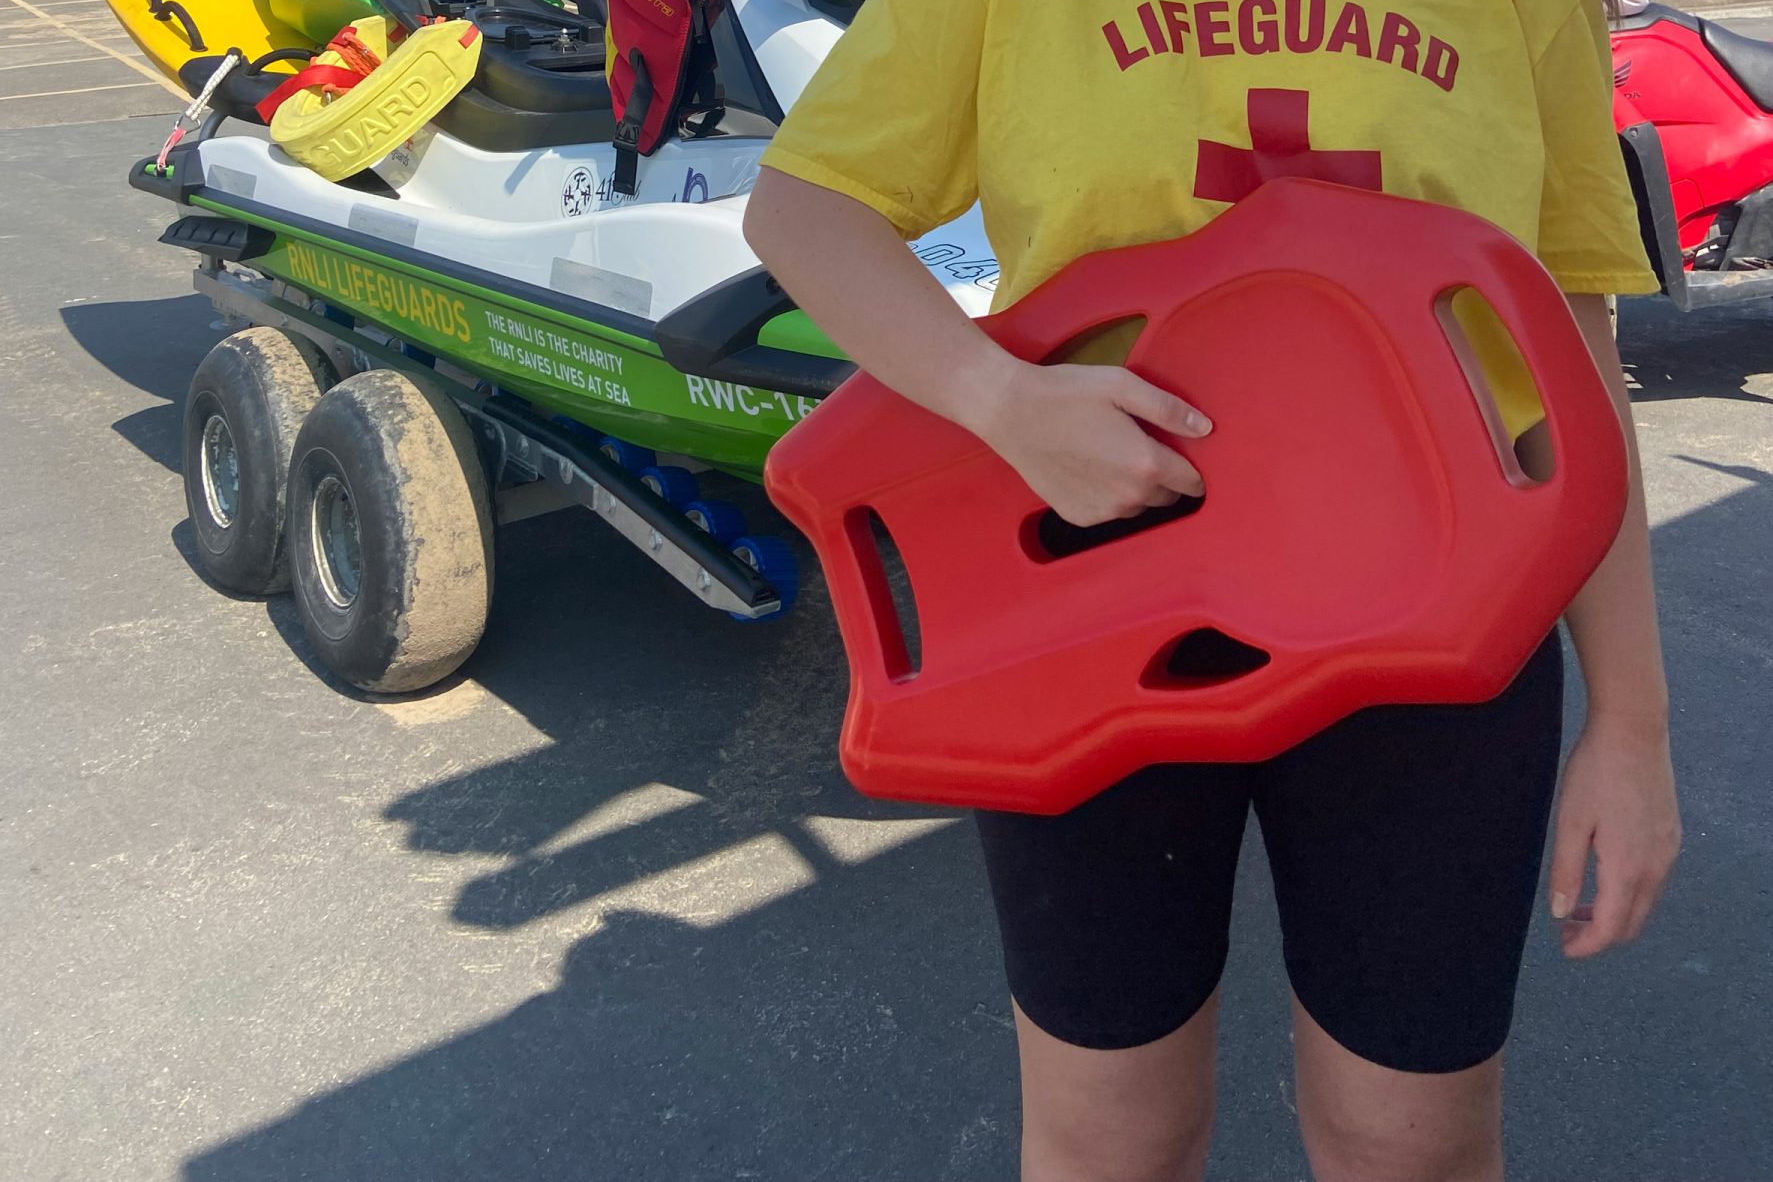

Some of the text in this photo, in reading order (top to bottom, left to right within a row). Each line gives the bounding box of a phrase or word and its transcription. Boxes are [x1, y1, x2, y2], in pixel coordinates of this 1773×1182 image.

[287, 242, 472, 344] RNLI LIFEGUARDS
[485, 311, 623, 376] THE RNLI IS THE CHARITY
[488, 337, 631, 406] THAT SAVES LIVES AT SEA
[686, 374, 823, 420] RWC-16
